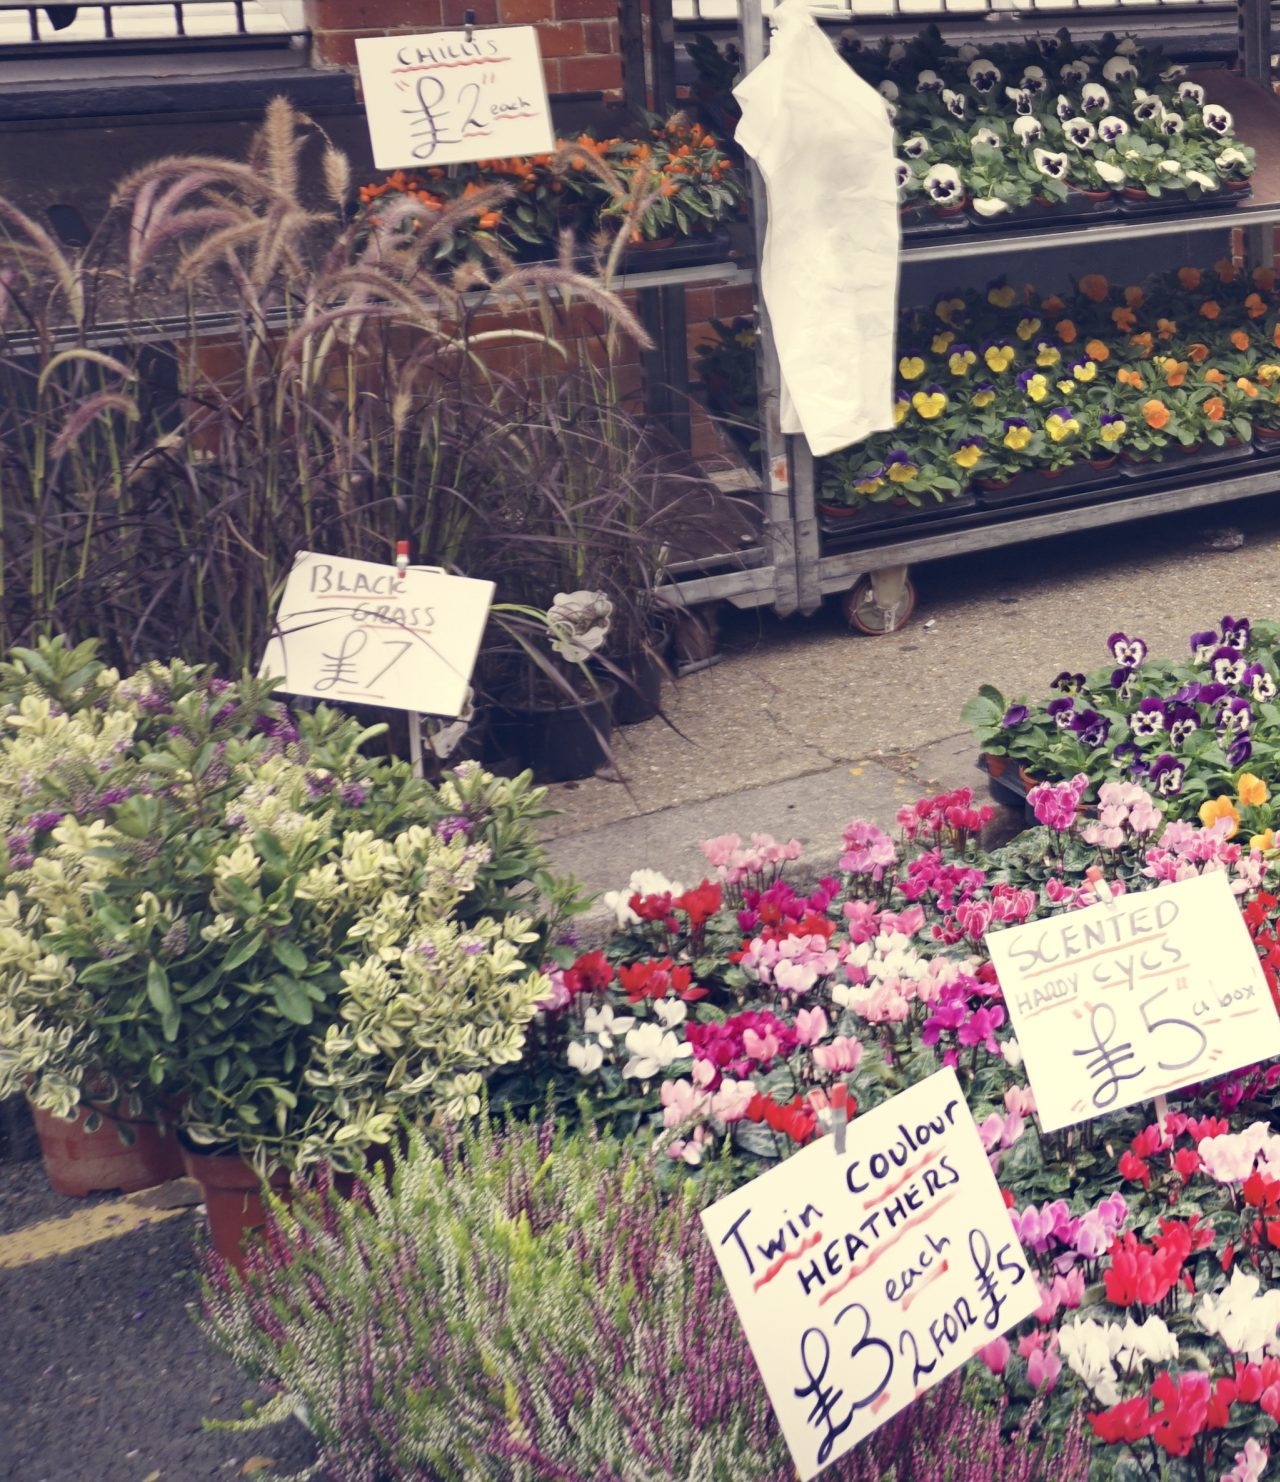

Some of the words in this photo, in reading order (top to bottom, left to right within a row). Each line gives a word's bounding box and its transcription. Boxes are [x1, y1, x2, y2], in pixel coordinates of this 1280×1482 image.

[490, 97, 532, 116] each
[310, 564, 407, 595] BLACK
[352, 602, 436, 627] GRASS
[313, 629, 414, 691] £7
[1008, 900, 1180, 972] SCENTED
[1015, 973, 1079, 1015] HARDY
[1092, 939, 1183, 991] CYCS
[1208, 978, 1256, 1008] box
[721, 1203, 824, 1274] Twin
[797, 1155, 960, 1296] HEATHERS
[968, 1229, 1027, 1330] £5
[794, 1303, 895, 1465] £3
[885, 1234, 951, 1302] each
